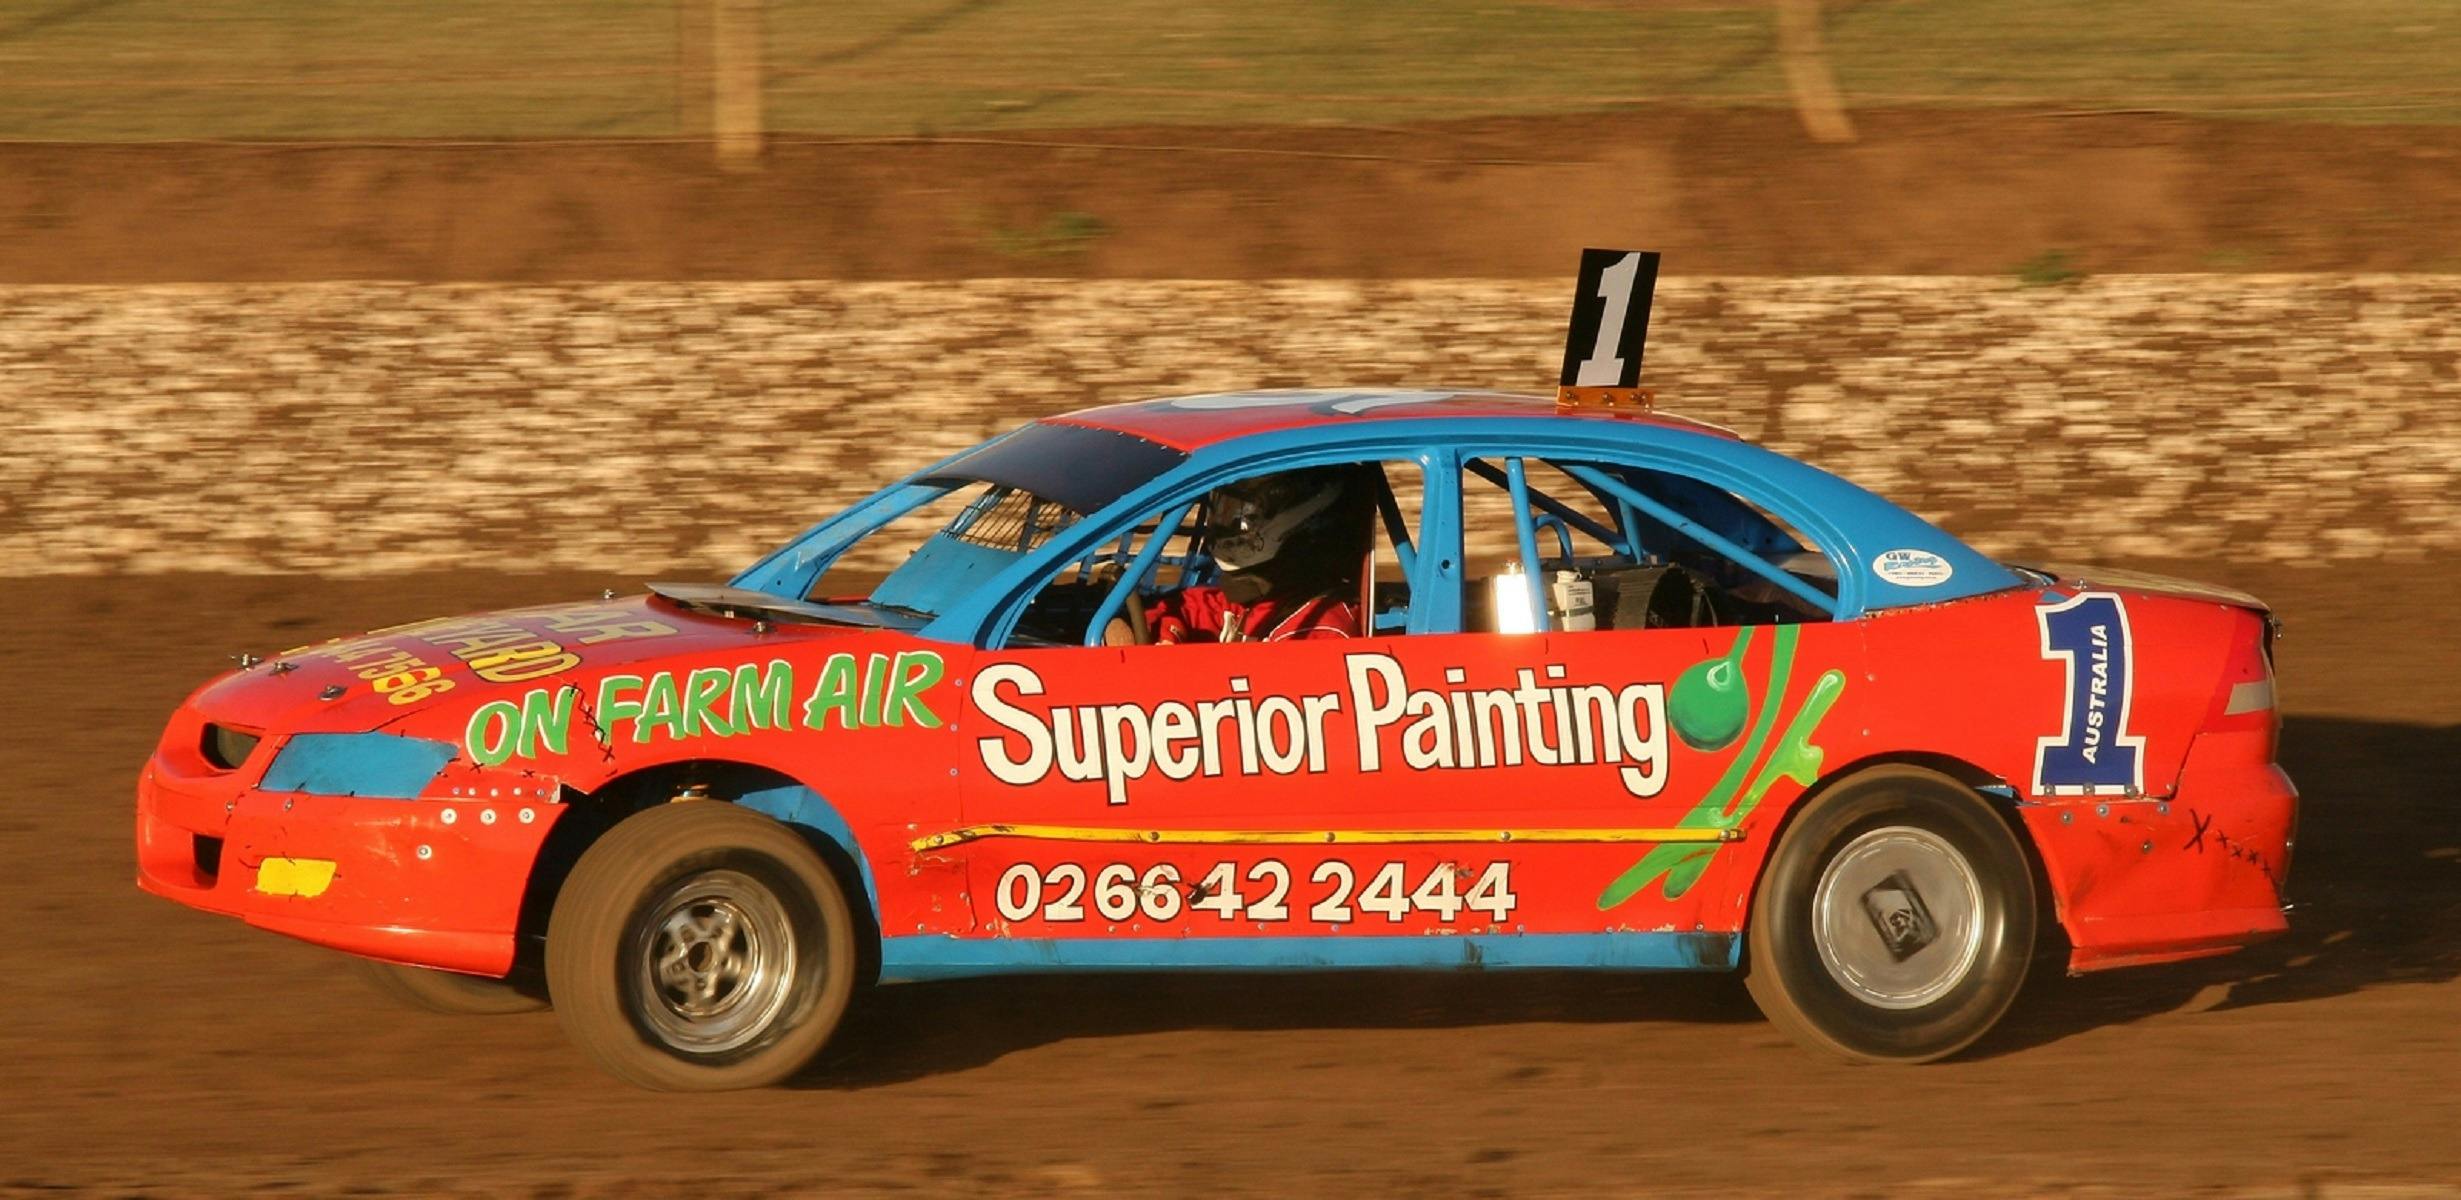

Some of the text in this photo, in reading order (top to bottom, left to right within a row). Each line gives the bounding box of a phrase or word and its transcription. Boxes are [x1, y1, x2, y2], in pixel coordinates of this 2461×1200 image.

[1576, 252, 1641, 387] 1
[465, 651, 945, 766] ON FARM AIR
[970, 652, 1672, 805] Superior Painting
[2032, 591, 2147, 796] 1
[2082, 624, 2108, 764] AUSTRALIA
[1309, 860, 1517, 923] 2444
